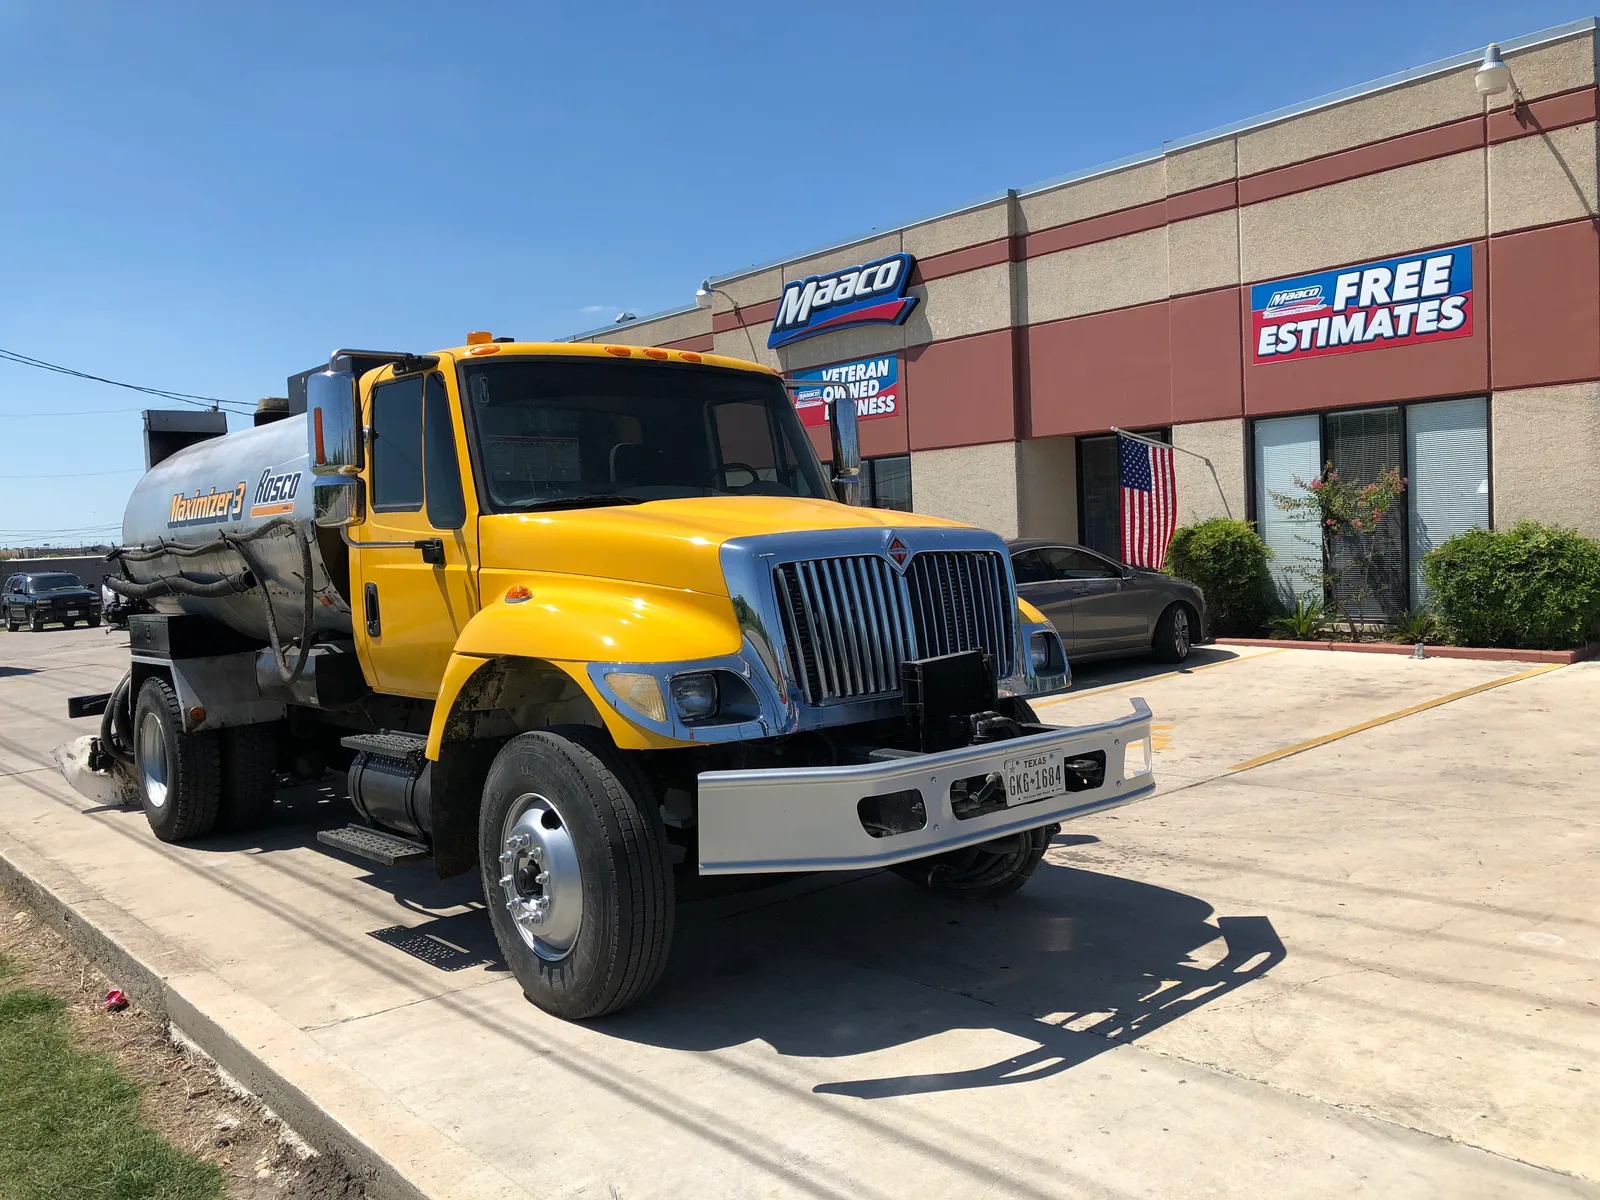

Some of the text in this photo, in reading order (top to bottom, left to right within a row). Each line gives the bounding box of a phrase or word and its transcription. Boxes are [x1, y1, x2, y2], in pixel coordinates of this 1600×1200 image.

[776, 259, 901, 328] Maaco
[1270, 287, 1320, 306] Maaco
[1333, 254, 1453, 312] FREE
[1257, 296, 1468, 356] ESTIMATES
[822, 359, 889, 383] VETERAN
[168, 481, 246, 527] Maximizer 3
[254, 467, 302, 504] Rosco
[1023, 756, 1047, 768] TEXAS
